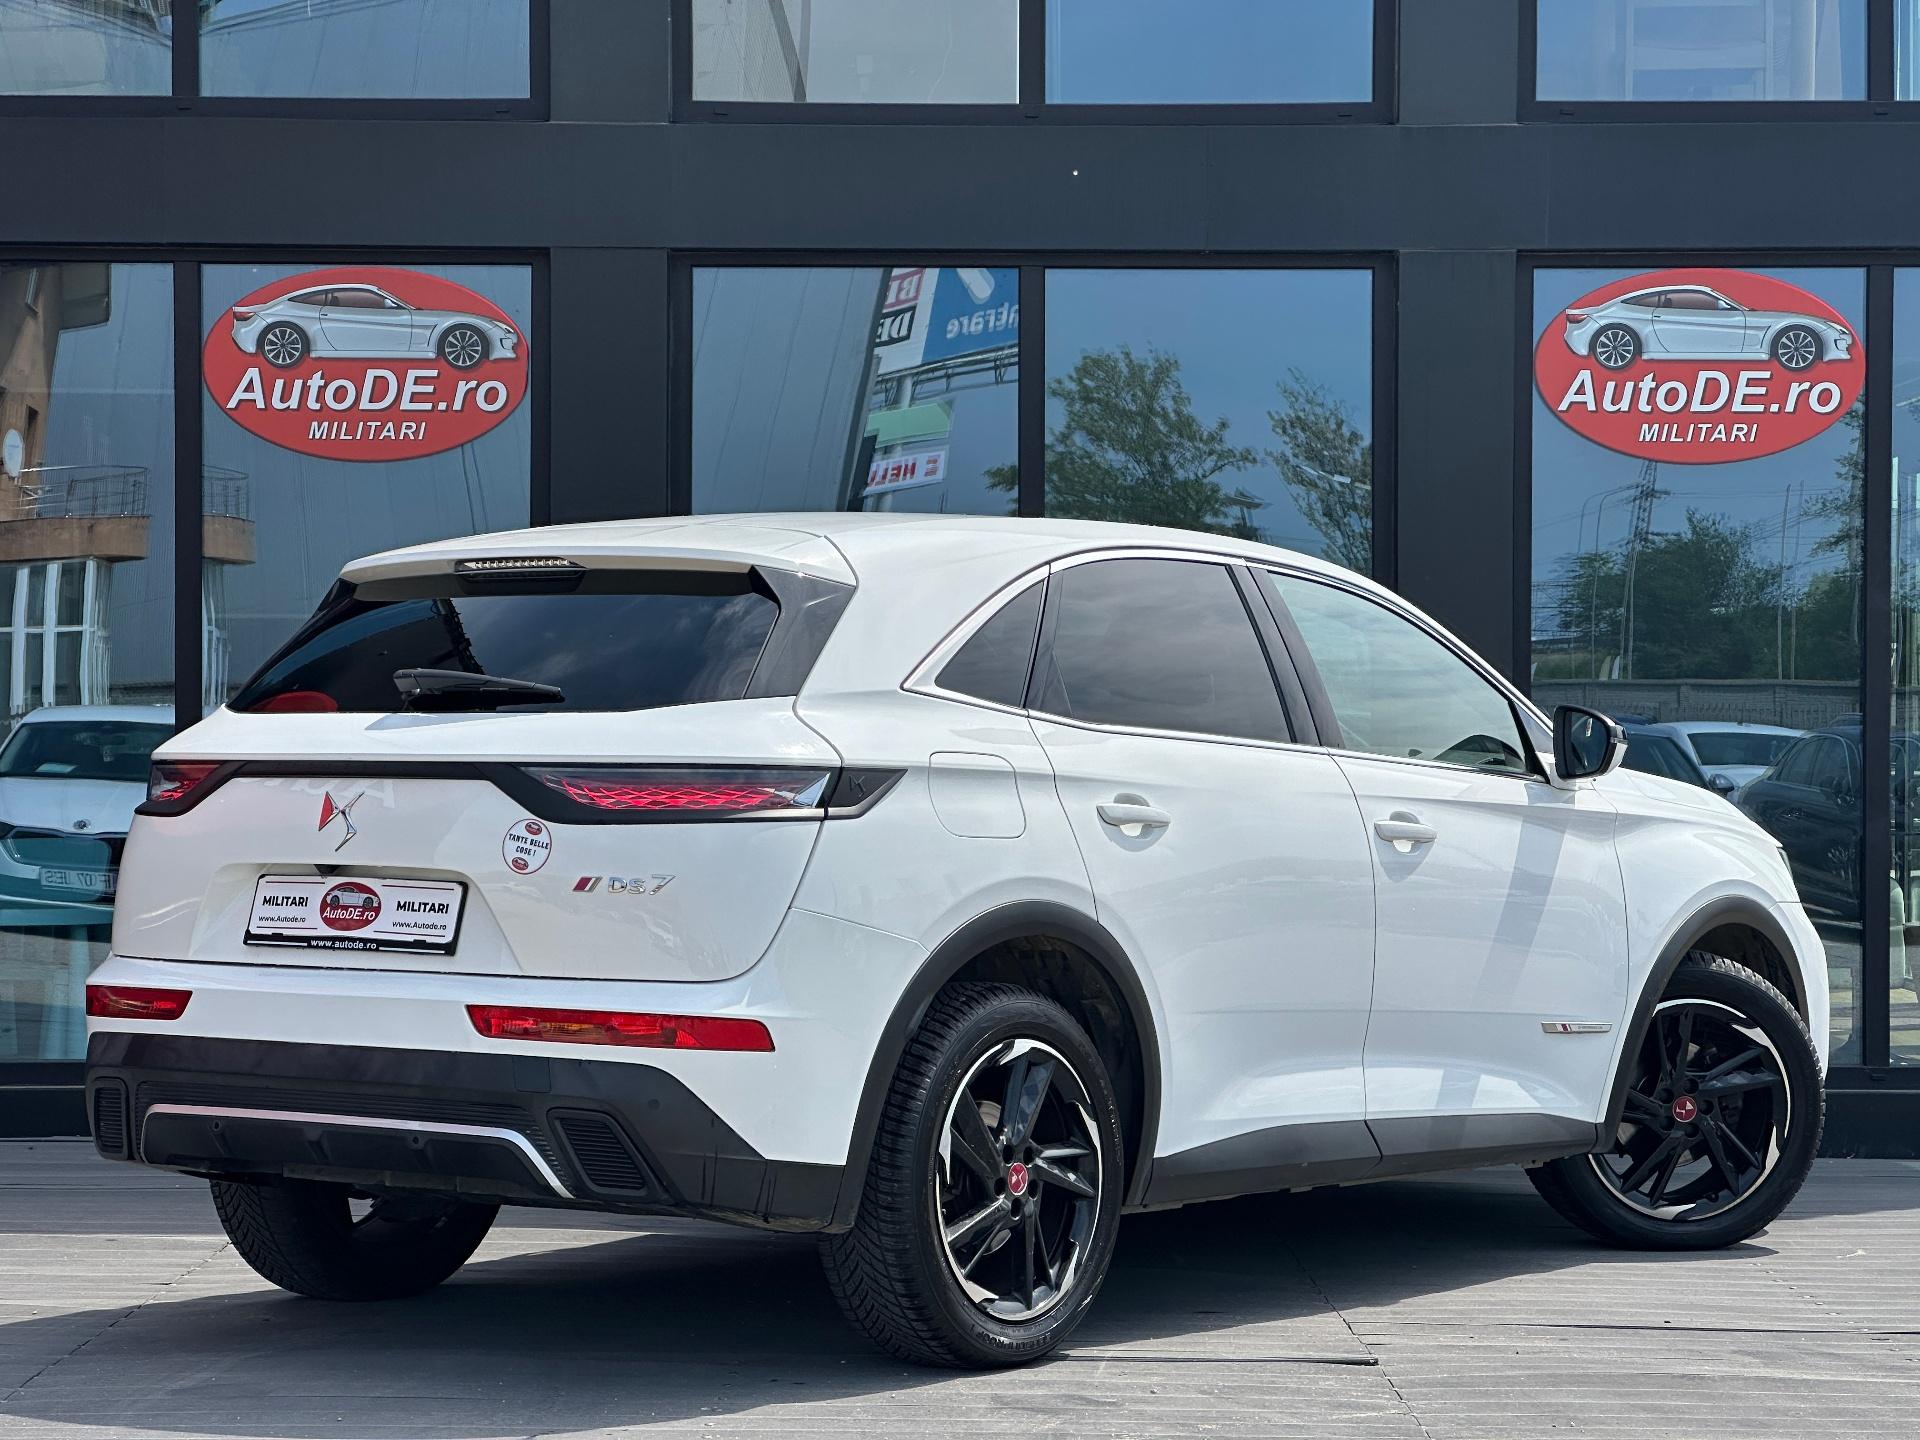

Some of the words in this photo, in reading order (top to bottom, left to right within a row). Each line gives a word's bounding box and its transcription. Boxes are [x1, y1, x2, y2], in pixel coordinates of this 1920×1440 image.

[226, 367, 507, 411] AutoDE.ro
[1558, 369, 1841, 413] AutoDE.ro
[308, 421, 426, 440] MILITARI
[1638, 423, 1758, 443] MILITARI
[508, 833, 528, 844] TANTE
[529, 838, 550, 850] BELLE
[262, 895, 309, 907] MILITARI
[396, 900, 450, 914] MILITARI
[258, 915, 306, 923] www.Autode.ro
[322, 906, 377, 921] AutoDE.ro
[392, 920, 447, 931] www.Autode.ro
[310, 938, 377, 950] www.autode.ro
